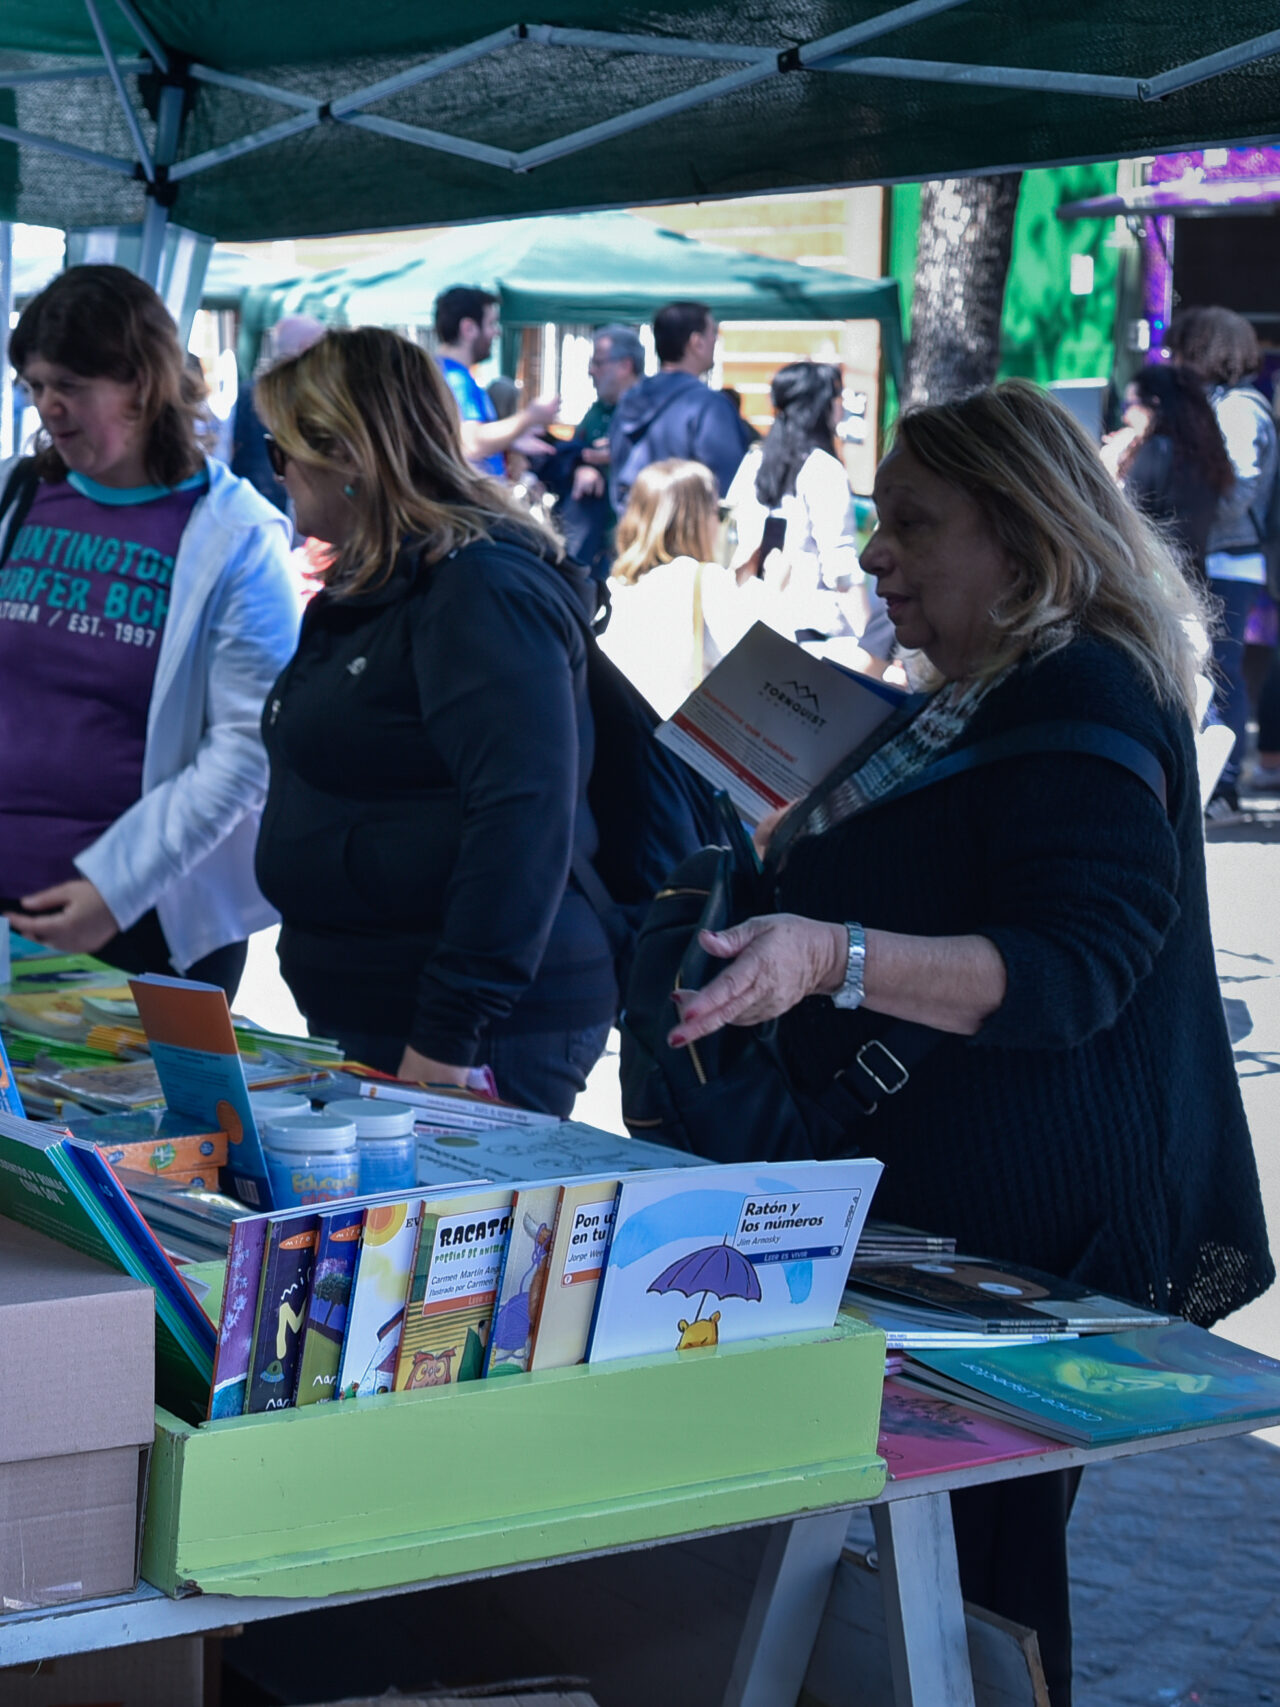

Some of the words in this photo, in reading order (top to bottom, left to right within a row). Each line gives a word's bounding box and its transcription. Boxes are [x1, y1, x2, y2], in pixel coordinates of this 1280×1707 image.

[69, 614, 105, 638] EST.
[115, 622, 156, 648] 1997
[763, 681, 828, 728] TORNQUIST
[744, 1201, 787, 1216] Ratón
[790, 1202, 800, 1217] y
[575, 1213, 600, 1229] Pon
[740, 1219, 760, 1233] los
[764, 1216, 824, 1231] números
[571, 1233, 588, 1245] en
[736, 1238, 751, 1247] Jim
[568, 1252, 588, 1263] Jorge
[431, 1273, 458, 1286] Carmen
[460, 1267, 483, 1280] Martín
[455, 1284, 466, 1294] por
[467, 1278, 494, 1290] Carmen
